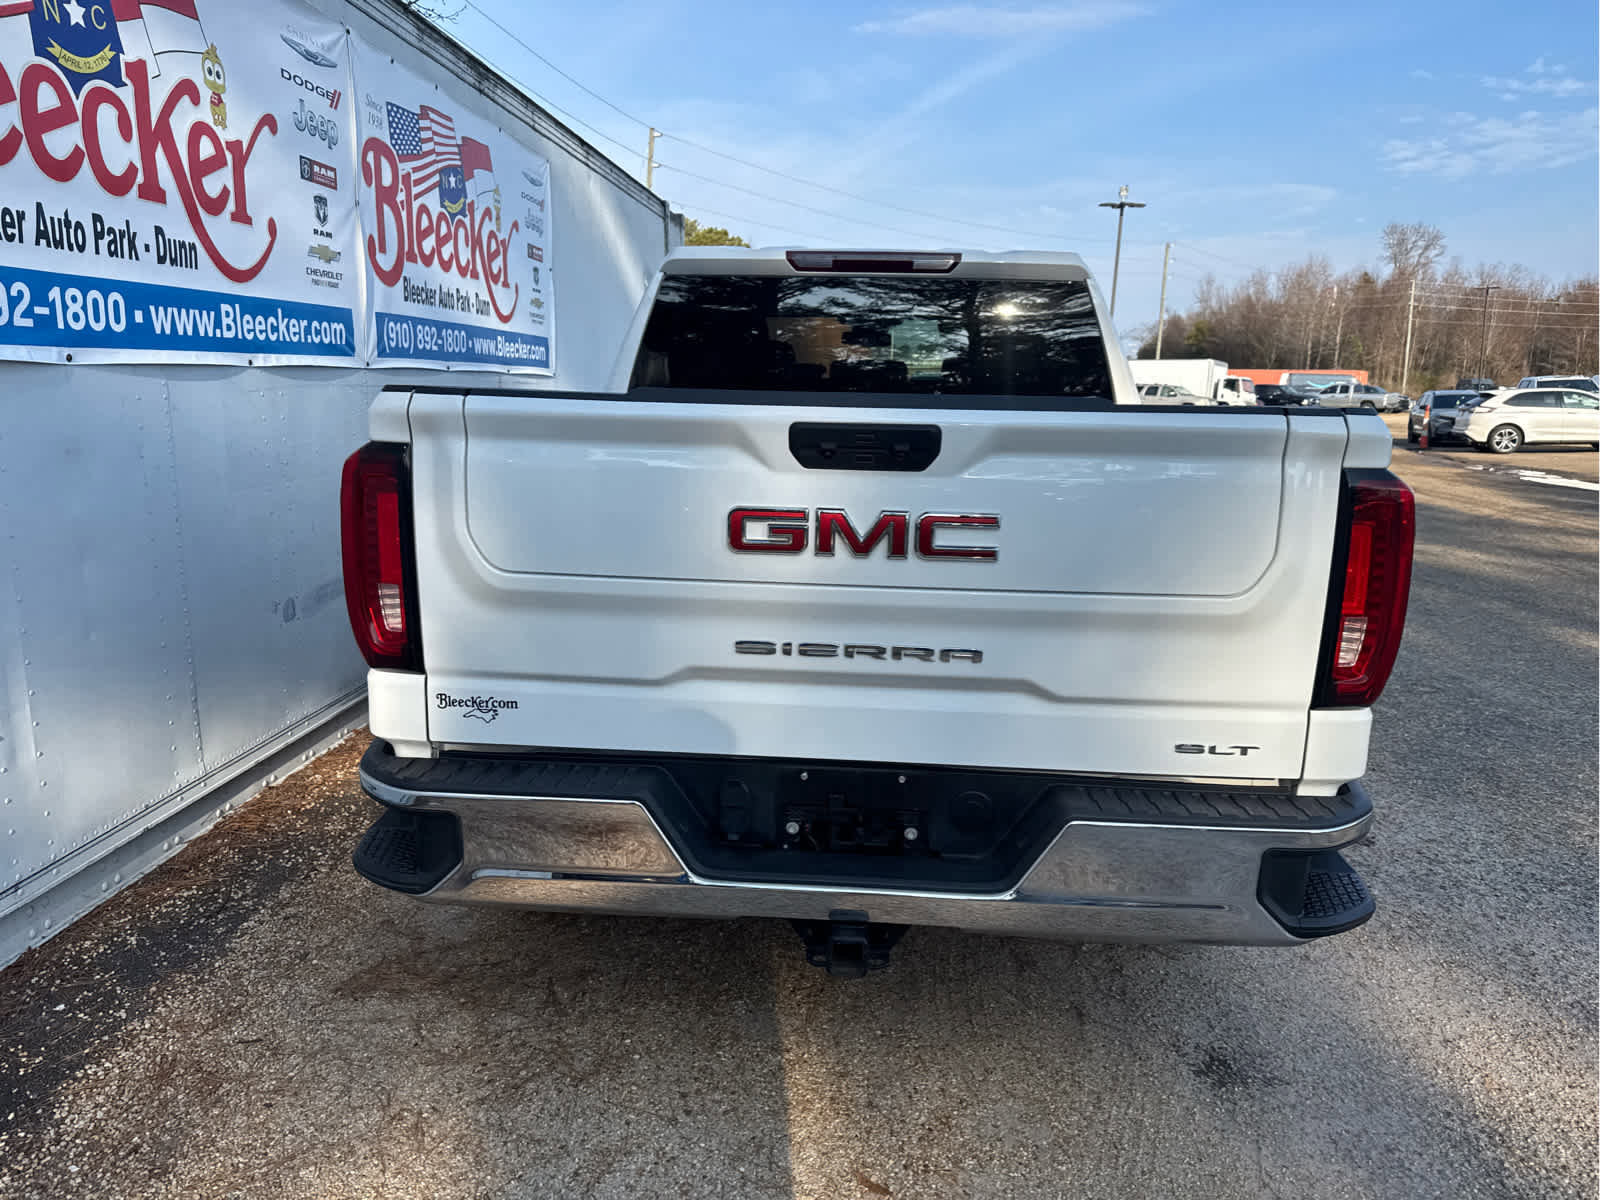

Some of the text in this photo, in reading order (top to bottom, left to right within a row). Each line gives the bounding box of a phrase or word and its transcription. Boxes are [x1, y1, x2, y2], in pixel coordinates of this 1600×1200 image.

[91, 5, 107, 30] C
[280, 67, 336, 101] DODGE
[292, 98, 338, 150] Jeep
[34, 201, 87, 253] Auto
[92, 212, 140, 261] Park
[154, 225, 199, 271] Dunn
[313, 228, 333, 240] RAM
[361, 136, 519, 324] Bleecker
[306, 266, 343, 281] CHEVROLET
[402, 275, 490, 317] Bleecker Auto Park Dunn
[150, 303, 346, 346] www.Bleecker.com
[383, 317, 546, 362] (910) 892-1800 www.Bleecker.com
[727, 504, 1001, 562] GMC
[734, 640, 984, 664] SIERRA
[1174, 743, 1261, 756] SLT
